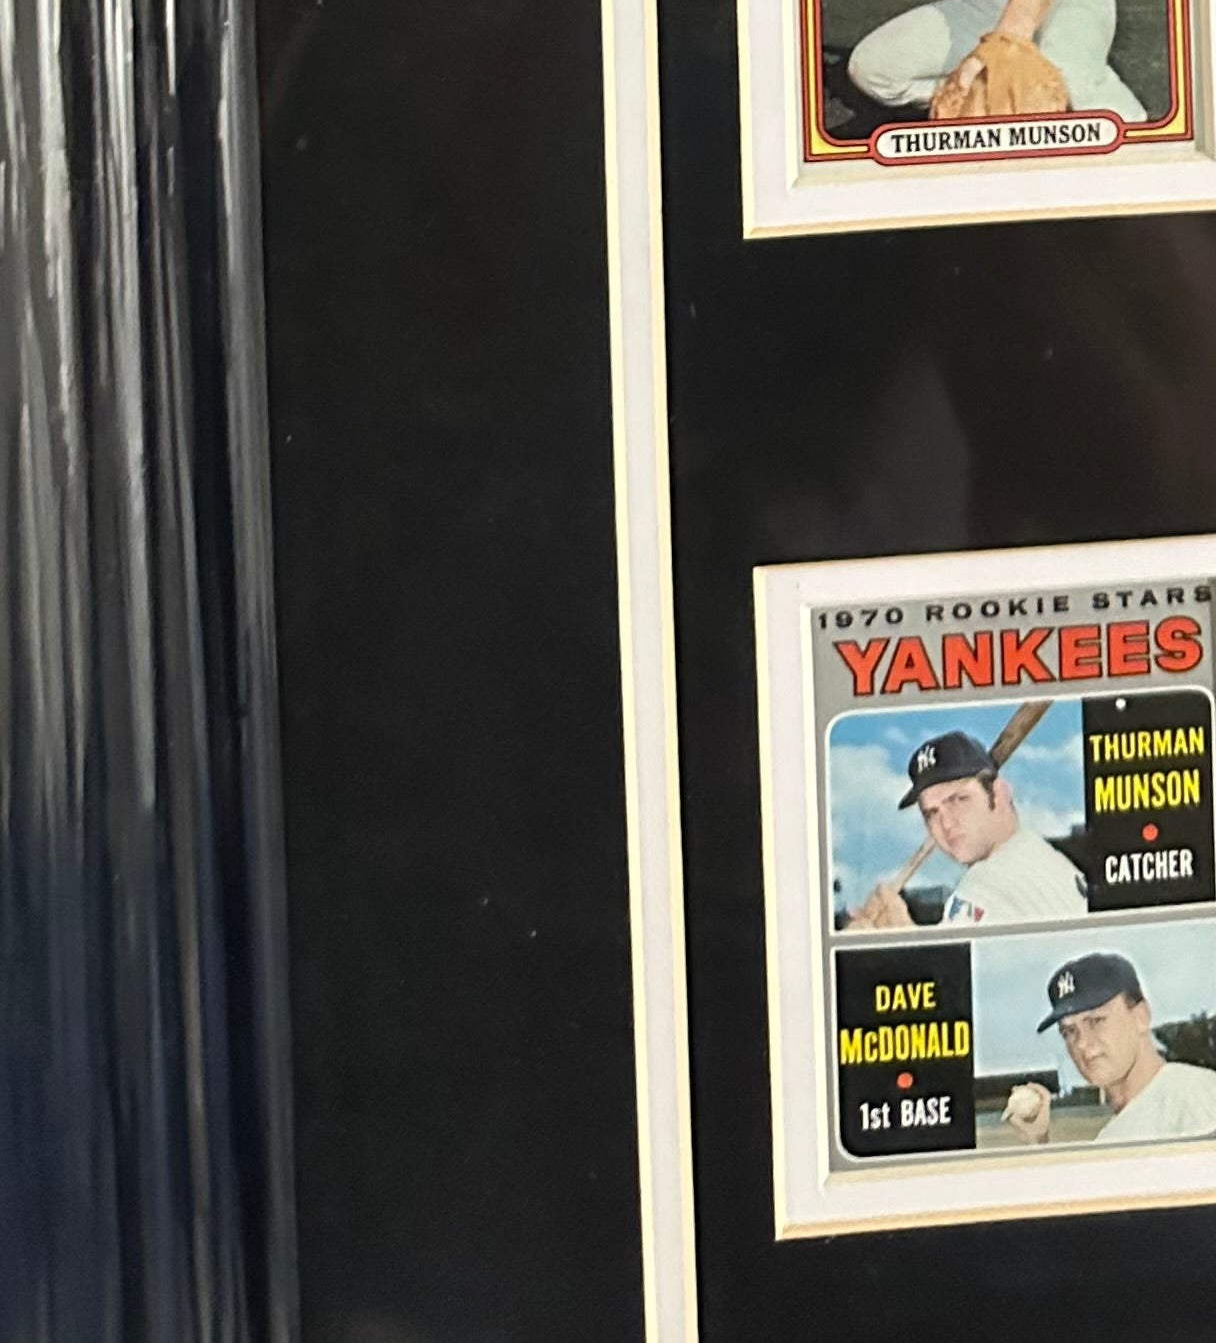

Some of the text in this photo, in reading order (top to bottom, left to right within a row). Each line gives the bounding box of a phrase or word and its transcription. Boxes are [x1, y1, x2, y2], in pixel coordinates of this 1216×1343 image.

[891, 122, 1101, 153] THURMAN MUNSON
[818, 585, 1213, 630] 1970 ROOKIE STARS
[833, 615, 1203, 697] YANKEES
[1089, 726, 1205, 762] THURMAN
[1094, 769, 1200, 813] MUNSON
[1105, 848, 1194, 884] CATCHER
[875, 982, 936, 1012] DAVE
[839, 1021, 970, 1064] McDONALD
[859, 1096, 951, 1131] 1st BASE
